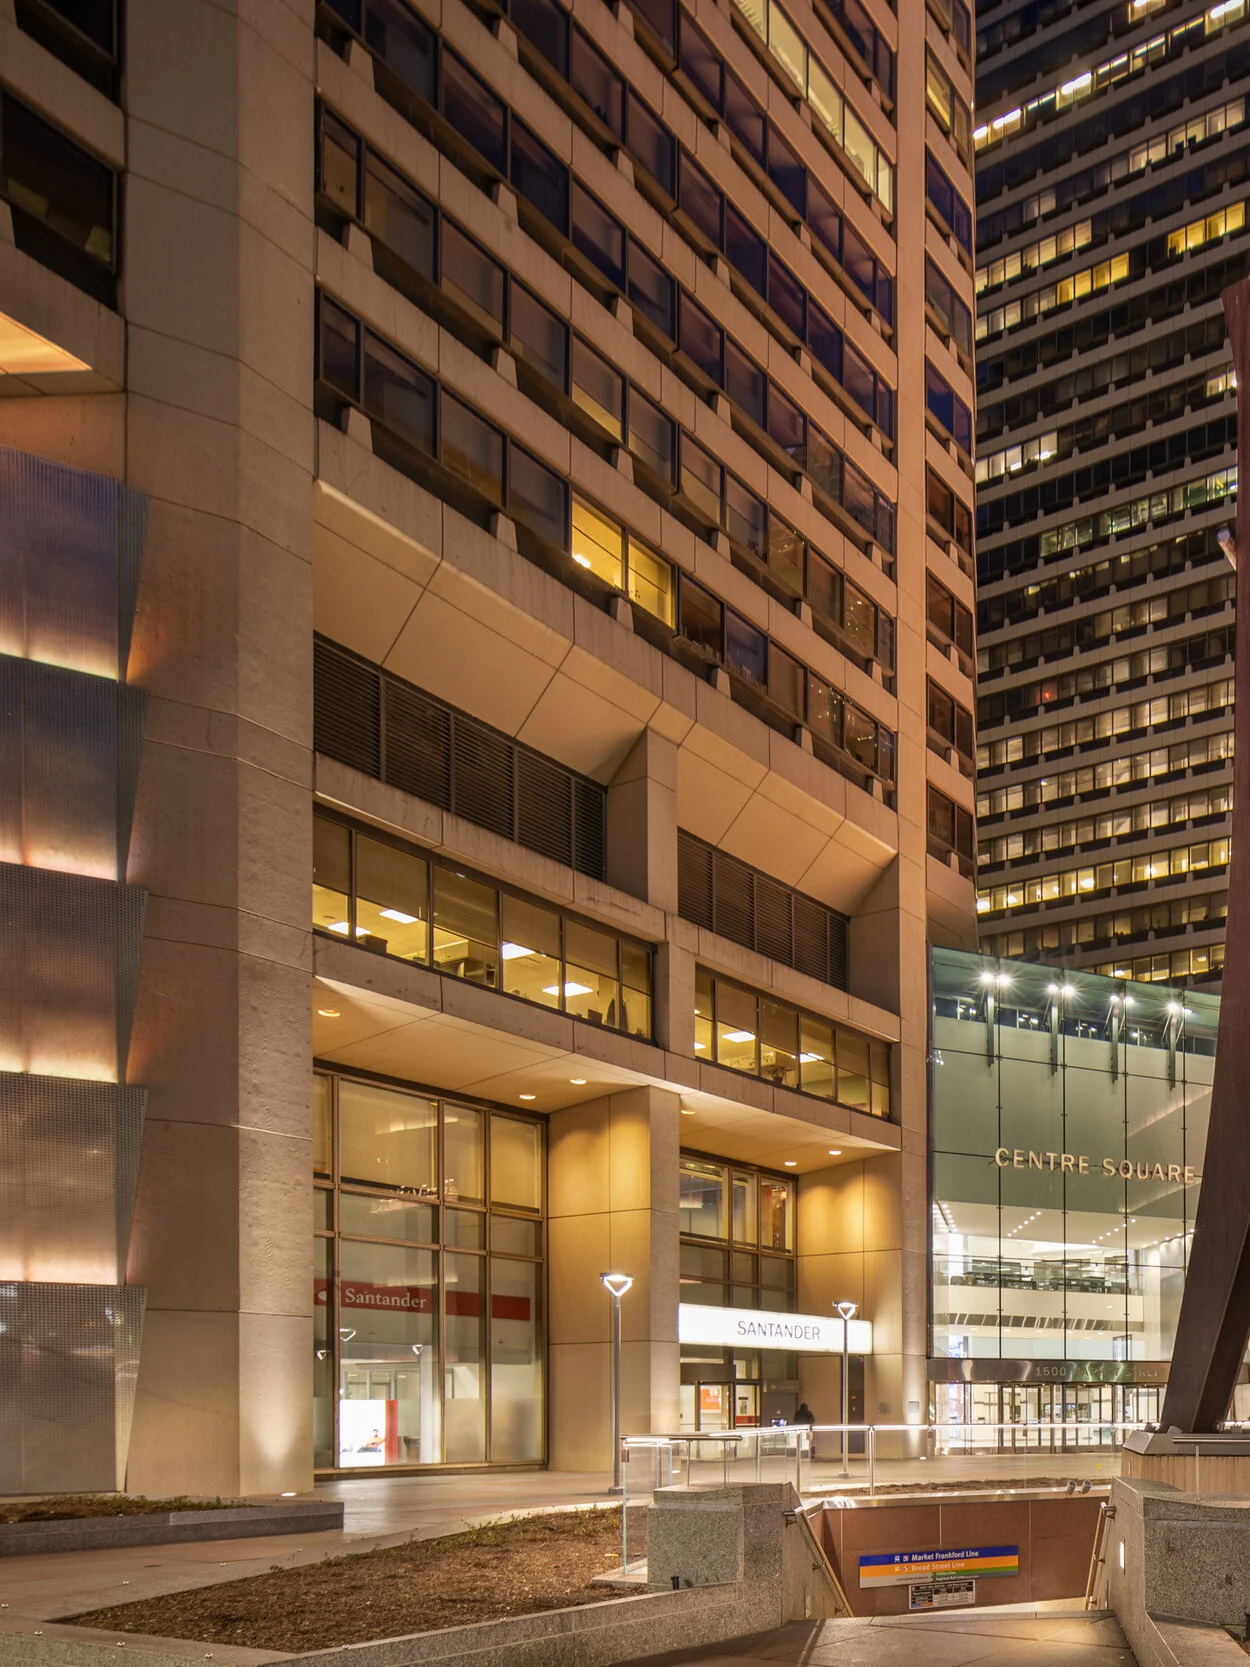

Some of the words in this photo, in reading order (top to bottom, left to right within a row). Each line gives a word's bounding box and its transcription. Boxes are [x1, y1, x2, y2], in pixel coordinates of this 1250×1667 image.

[995, 1147, 1090, 1175] CENTRE
[1102, 1157, 1196, 1184] SQUARE
[345, 1288, 427, 1309] Santander
[737, 1320, 821, 1341] SANTANDER
[1035, 1366, 1067, 1376] 1500
[911, 1553, 934, 1561] Market
[935, 1551, 964, 1560] Frankford
[911, 1563, 930, 1571] Broad
